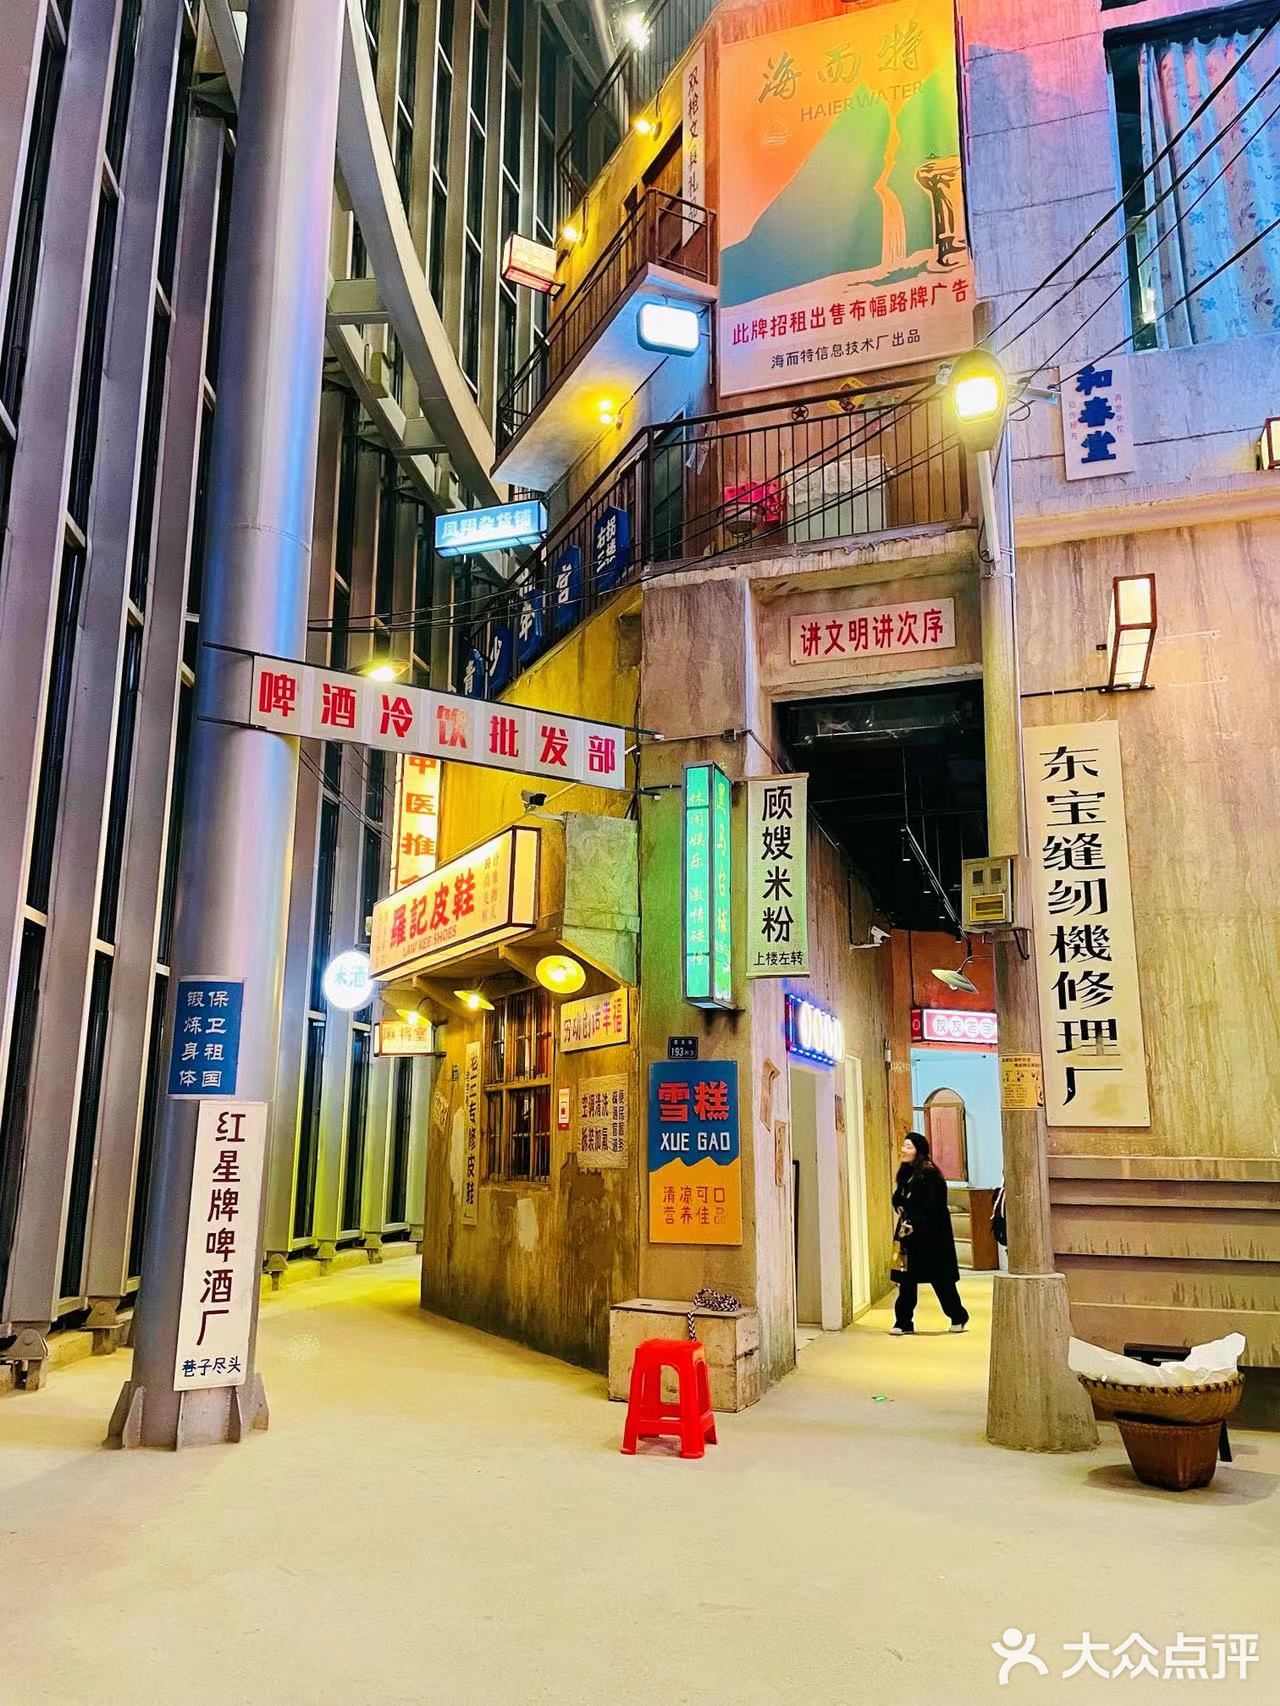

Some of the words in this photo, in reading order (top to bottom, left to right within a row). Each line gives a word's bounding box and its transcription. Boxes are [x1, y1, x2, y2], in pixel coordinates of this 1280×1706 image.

[759, 21, 924, 103] 海而特
[732, 278, 968, 346] 此牌招租出售布幅路牌广告
[771, 328, 921, 369] 海而特信息技术厂出品
[800, 608, 945, 656] 讲文明讲次序
[258, 671, 616, 774] 啤酒冷饮批发部
[400, 756, 437, 885] 中医推
[761, 785, 794, 943] 顾嫂米粉
[753, 951, 803, 967] 上楼左转
[658, 1081, 730, 1122] 雪糕
[660, 1132, 690, 1151] XUE
[697, 1131, 731, 1151] GAO
[663, 1186, 726, 1203] 清凉可口
[664, 1206, 726, 1225] 营养佳品
[197, 1111, 247, 1346] 红星牌啤酒厂
[182, 1355, 241, 1377] 巷子尽头
